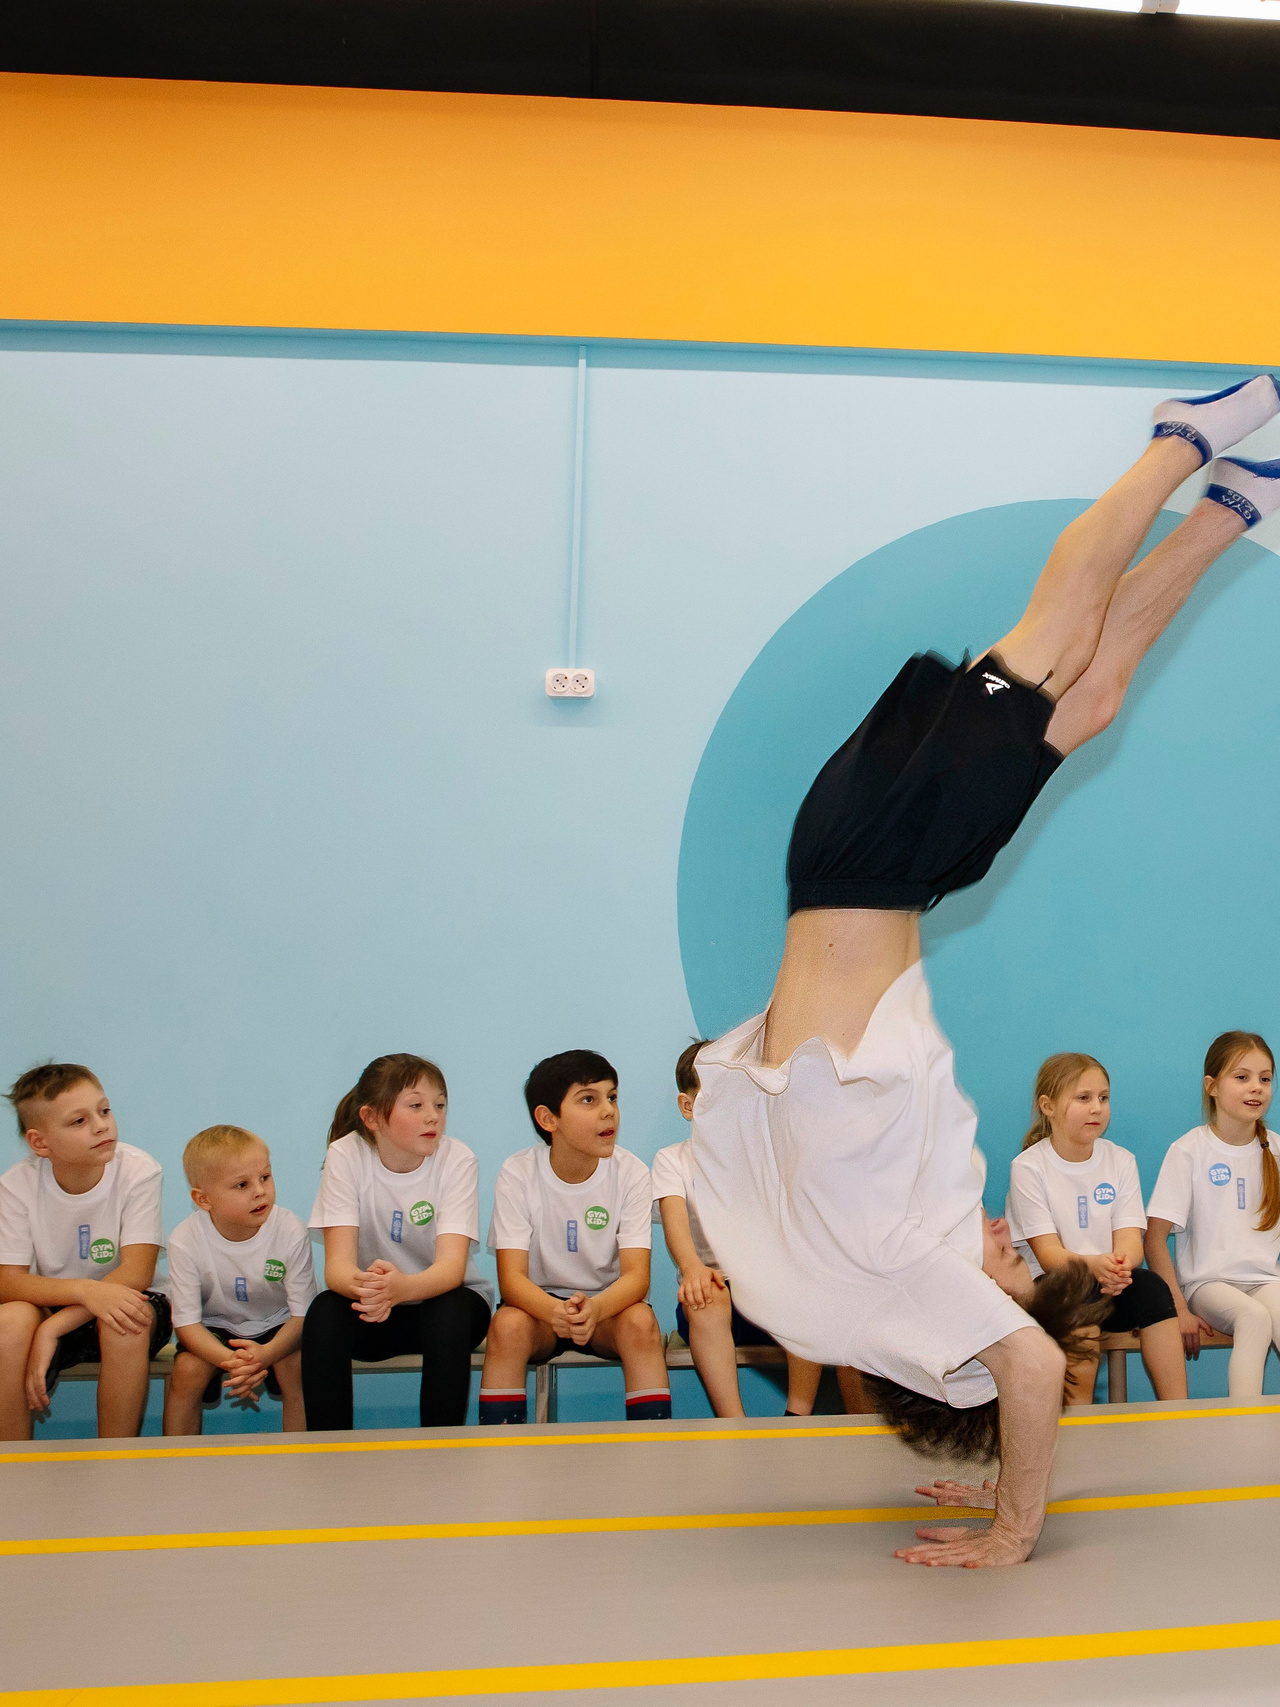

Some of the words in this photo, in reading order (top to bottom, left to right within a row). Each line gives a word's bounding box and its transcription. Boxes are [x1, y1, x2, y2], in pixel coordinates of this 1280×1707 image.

[1221, 494, 1253, 521] GYM
[1210, 1167, 1230, 1176] GYM
[1095, 1187, 1114, 1195] GYM
[410, 1204, 432, 1217] GYM
[586, 1210, 607, 1219] GYM
[91, 1243, 113, 1253] GYM
